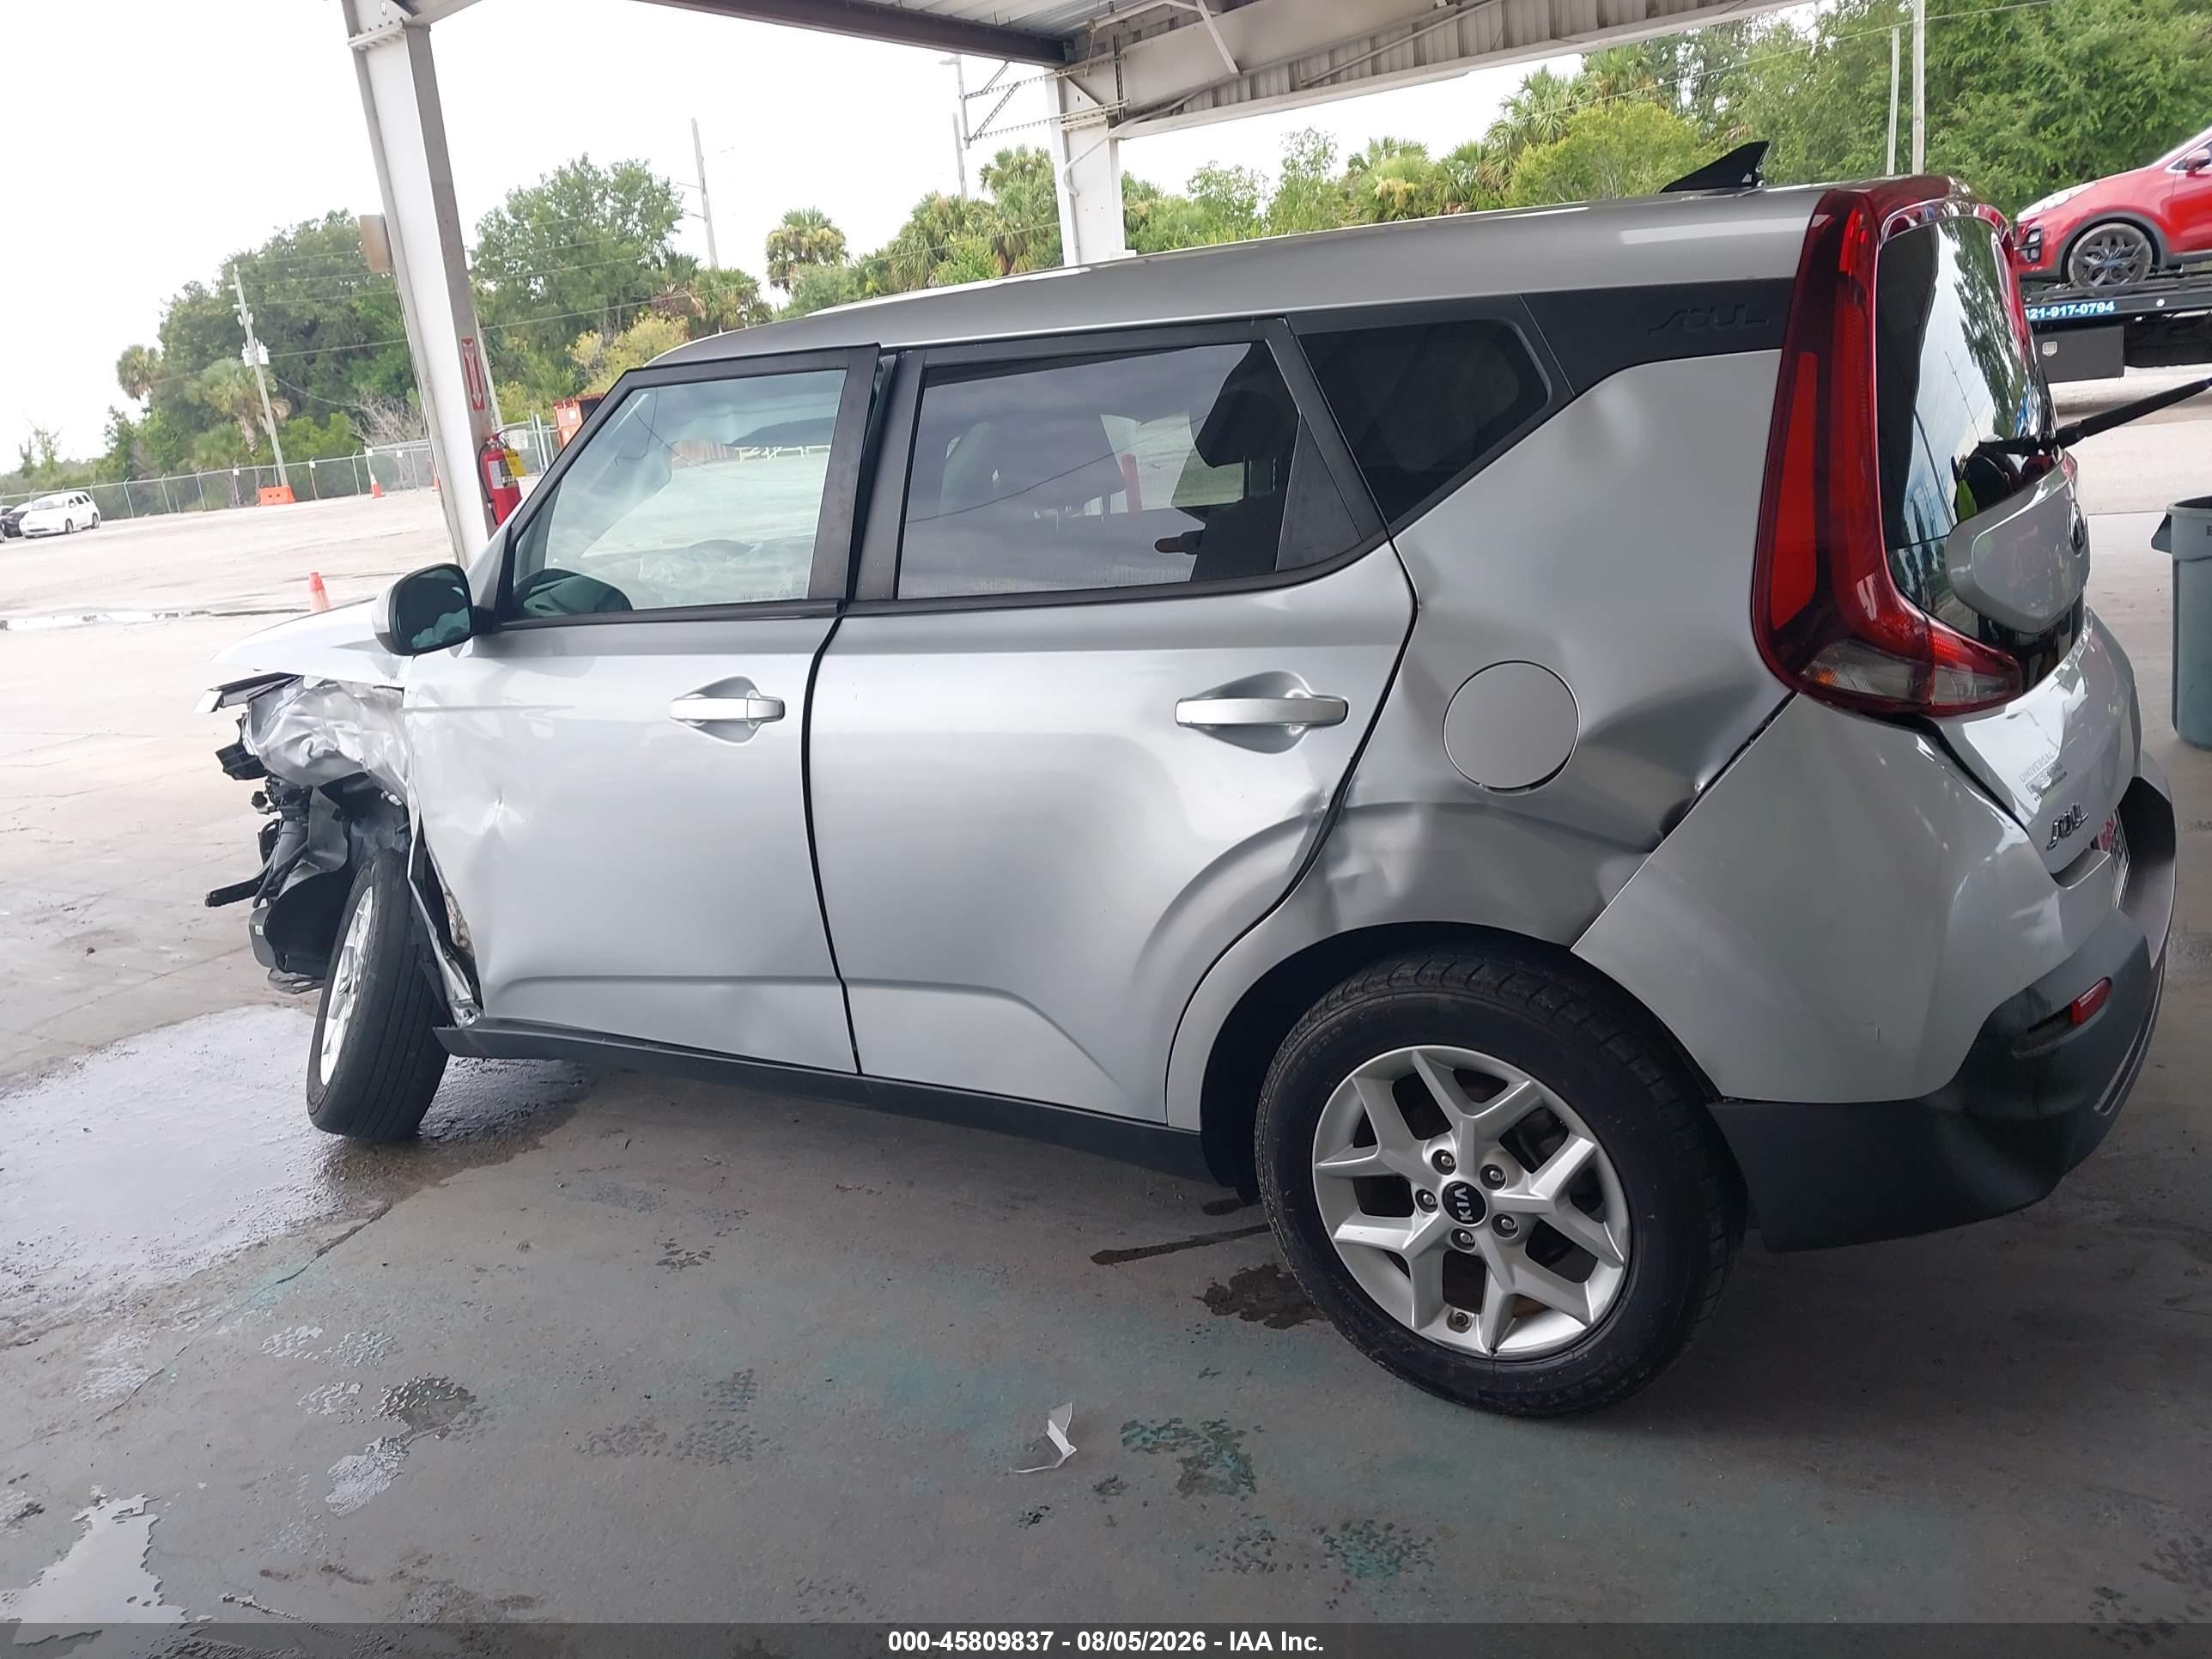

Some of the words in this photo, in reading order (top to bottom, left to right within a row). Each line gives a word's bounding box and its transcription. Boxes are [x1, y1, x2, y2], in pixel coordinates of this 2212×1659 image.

[2019, 750, 2057, 782] UNIVERSAL
[2046, 803, 2089, 851] SOUL
[1454, 1187, 1474, 1221] KIA
